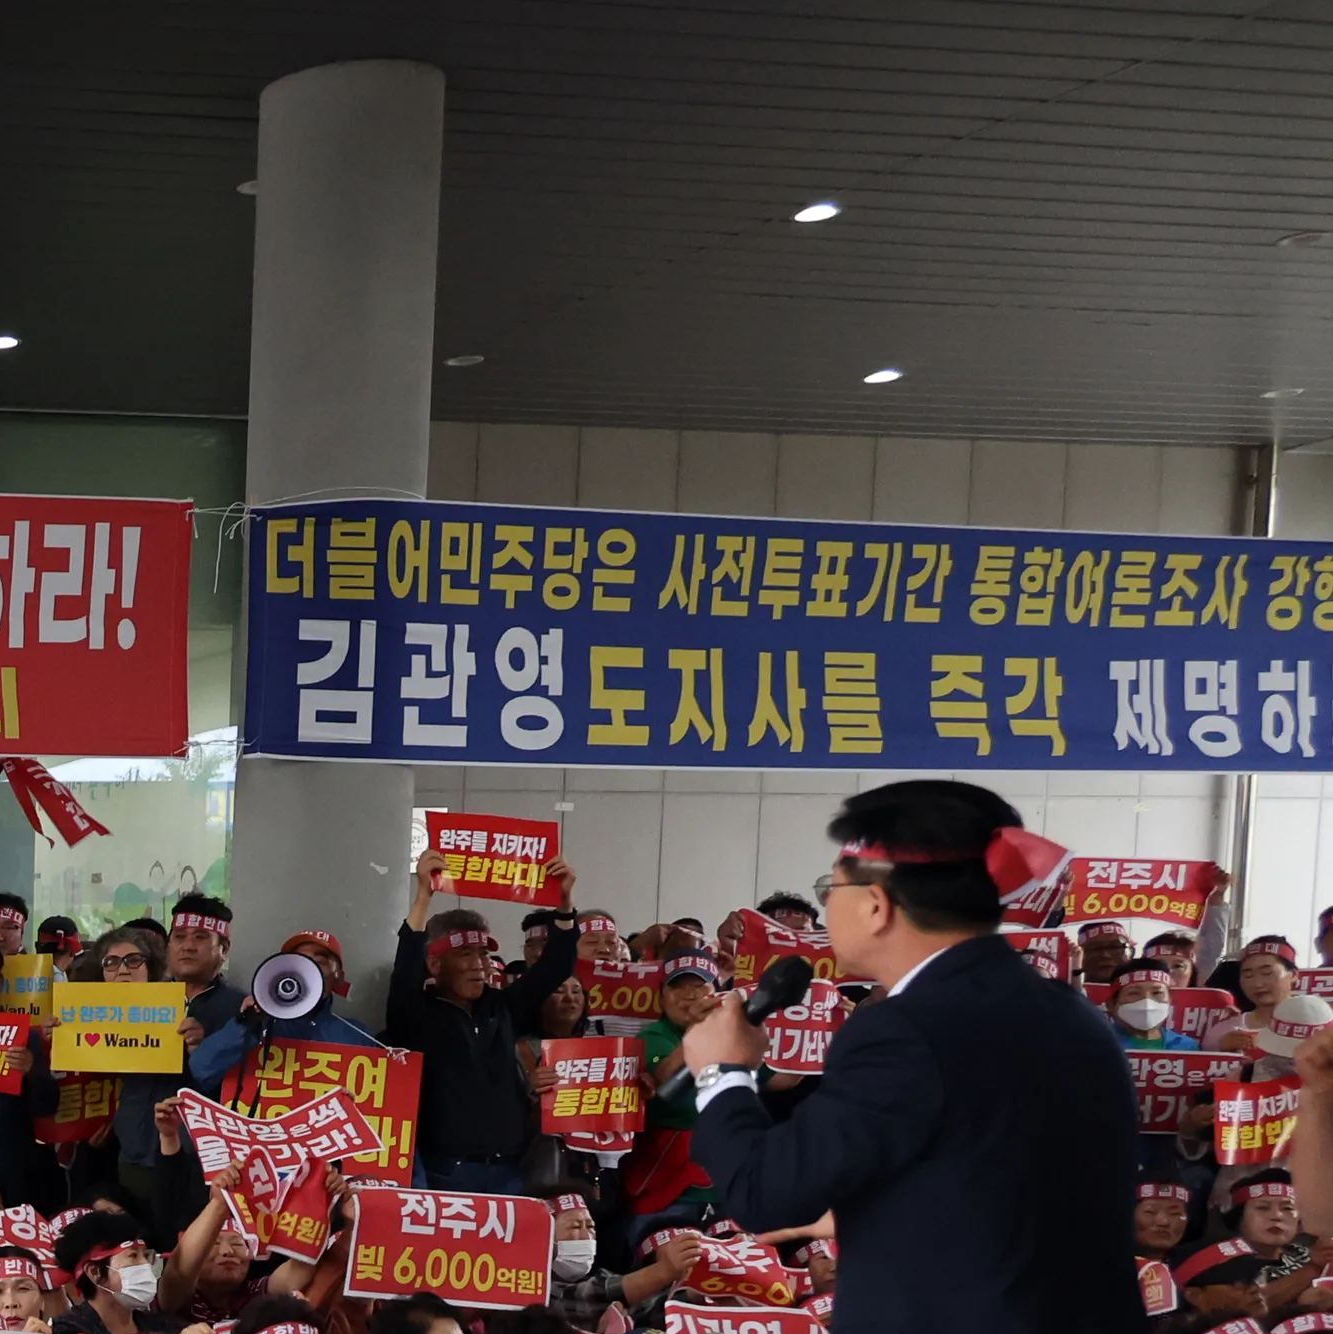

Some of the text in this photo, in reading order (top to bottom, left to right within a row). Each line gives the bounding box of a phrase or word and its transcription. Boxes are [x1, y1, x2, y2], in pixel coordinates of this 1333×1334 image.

[659, 541, 953, 625] 사전투표기간
[969, 546, 1248, 629] 통합여론조사
[929, 652, 1065, 756] 즉각
[440, 829, 488, 852] 완주를
[491, 833, 547, 859] 지키자!
[442, 853, 547, 888] 통합반대!
[1087, 861, 1187, 891] 전주시
[61, 1007, 76, 1023] 난
[80, 1007, 123, 1023] 완주가
[555, 1057, 607, 1082] 완주를
[1219, 1099, 1254, 1122] 완주를
[398, 1192, 516, 1243] 전주시
[356, 1245, 543, 1295] 빚 6,000억원!
